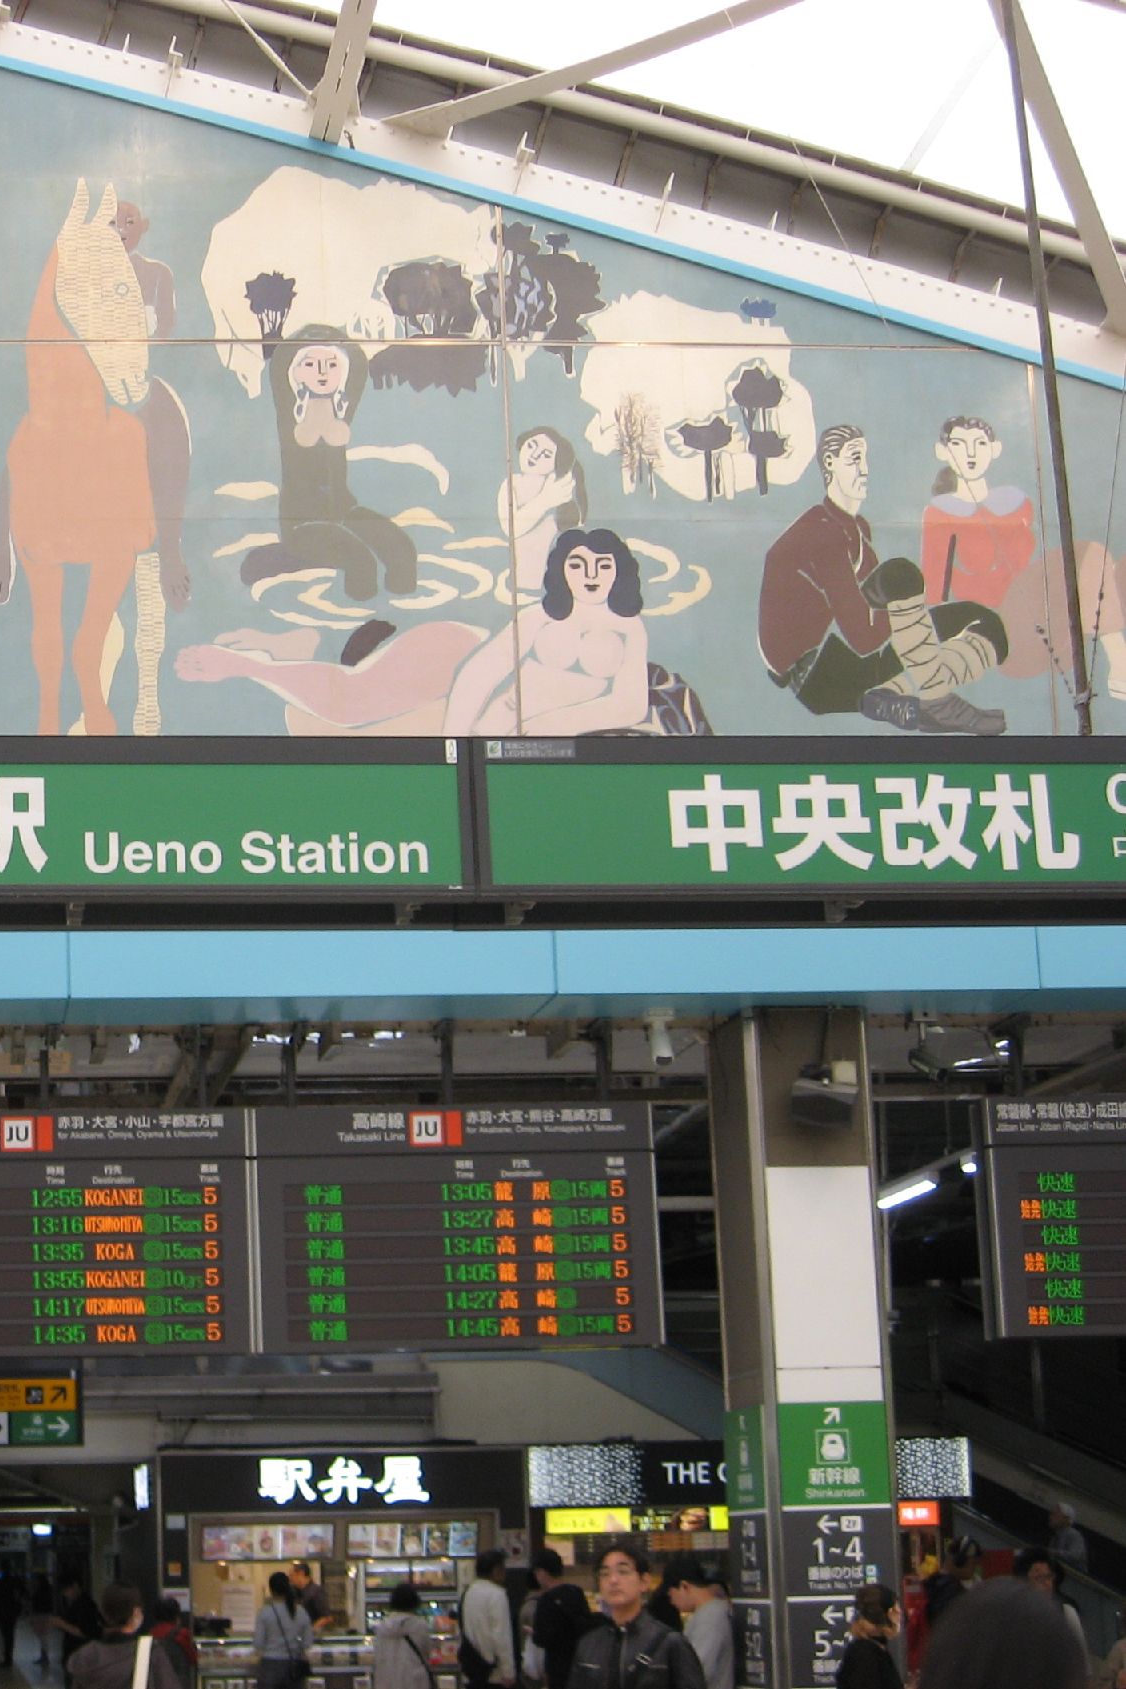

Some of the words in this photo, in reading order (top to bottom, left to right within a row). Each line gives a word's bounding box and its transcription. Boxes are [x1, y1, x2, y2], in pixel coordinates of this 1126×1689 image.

[668, 773, 1080, 872] 中央改札
[83, 831, 223, 874] Ueno
[240, 830, 430, 874] Station
[6, 1124, 29, 1142] JU
[384, 1130, 406, 1141] Line
[415, 1120, 438, 1138] JU
[304, 1185, 342, 1205] 普通
[441, 1183, 492, 1201] 13:05
[610, 1179, 624, 1197] 5
[1038, 1172, 1074, 1192] 快速
[32, 1189, 82, 1207] 12:55
[84, 1188, 144, 1206] KOGANEI
[204, 1187, 216, 1204] 5
[305, 1212, 343, 1232] 普通
[442, 1210, 493, 1228] 13:27
[612, 1206, 625, 1224] 5
[1042, 1199, 1076, 1219] 快速
[32, 1215, 83, 1234] 13:16
[204, 1214, 217, 1232] 5
[1042, 1225, 1079, 1245] 快速
[33, 1242, 84, 1261] 13:35
[96, 1243, 134, 1260] KOGA
[205, 1241, 218, 1259] 5
[306, 1239, 345, 1259] 普通
[443, 1236, 496, 1255] 13:45
[612, 1233, 627, 1250] 5
[1045, 1253, 1081, 1272] 快速
[33, 1271, 84, 1289] 13:55
[85, 1271, 145, 1288] KOGANEI
[205, 1268, 218, 1286] 5
[307, 1266, 345, 1286] 普通
[444, 1264, 496, 1282] 14:05
[615, 1260, 628, 1277] 5
[1045, 1279, 1083, 1299] 快速
[34, 1298, 83, 1316] 14:17
[206, 1296, 219, 1313] 5
[308, 1294, 346, 1313] 普通
[445, 1291, 497, 1309] 14:27
[616, 1287, 629, 1305] 5
[1049, 1306, 1085, 1325] 快速
[34, 1326, 85, 1343] 14:35
[97, 1325, 136, 1343] KOGA
[206, 1323, 220, 1341] 5
[309, 1320, 347, 1341] 普通
[447, 1318, 499, 1336] 14:45
[617, 1314, 631, 1331] 5
[258, 1455, 430, 1505] 駅弁屋
[662, 1462, 711, 1484] THE
